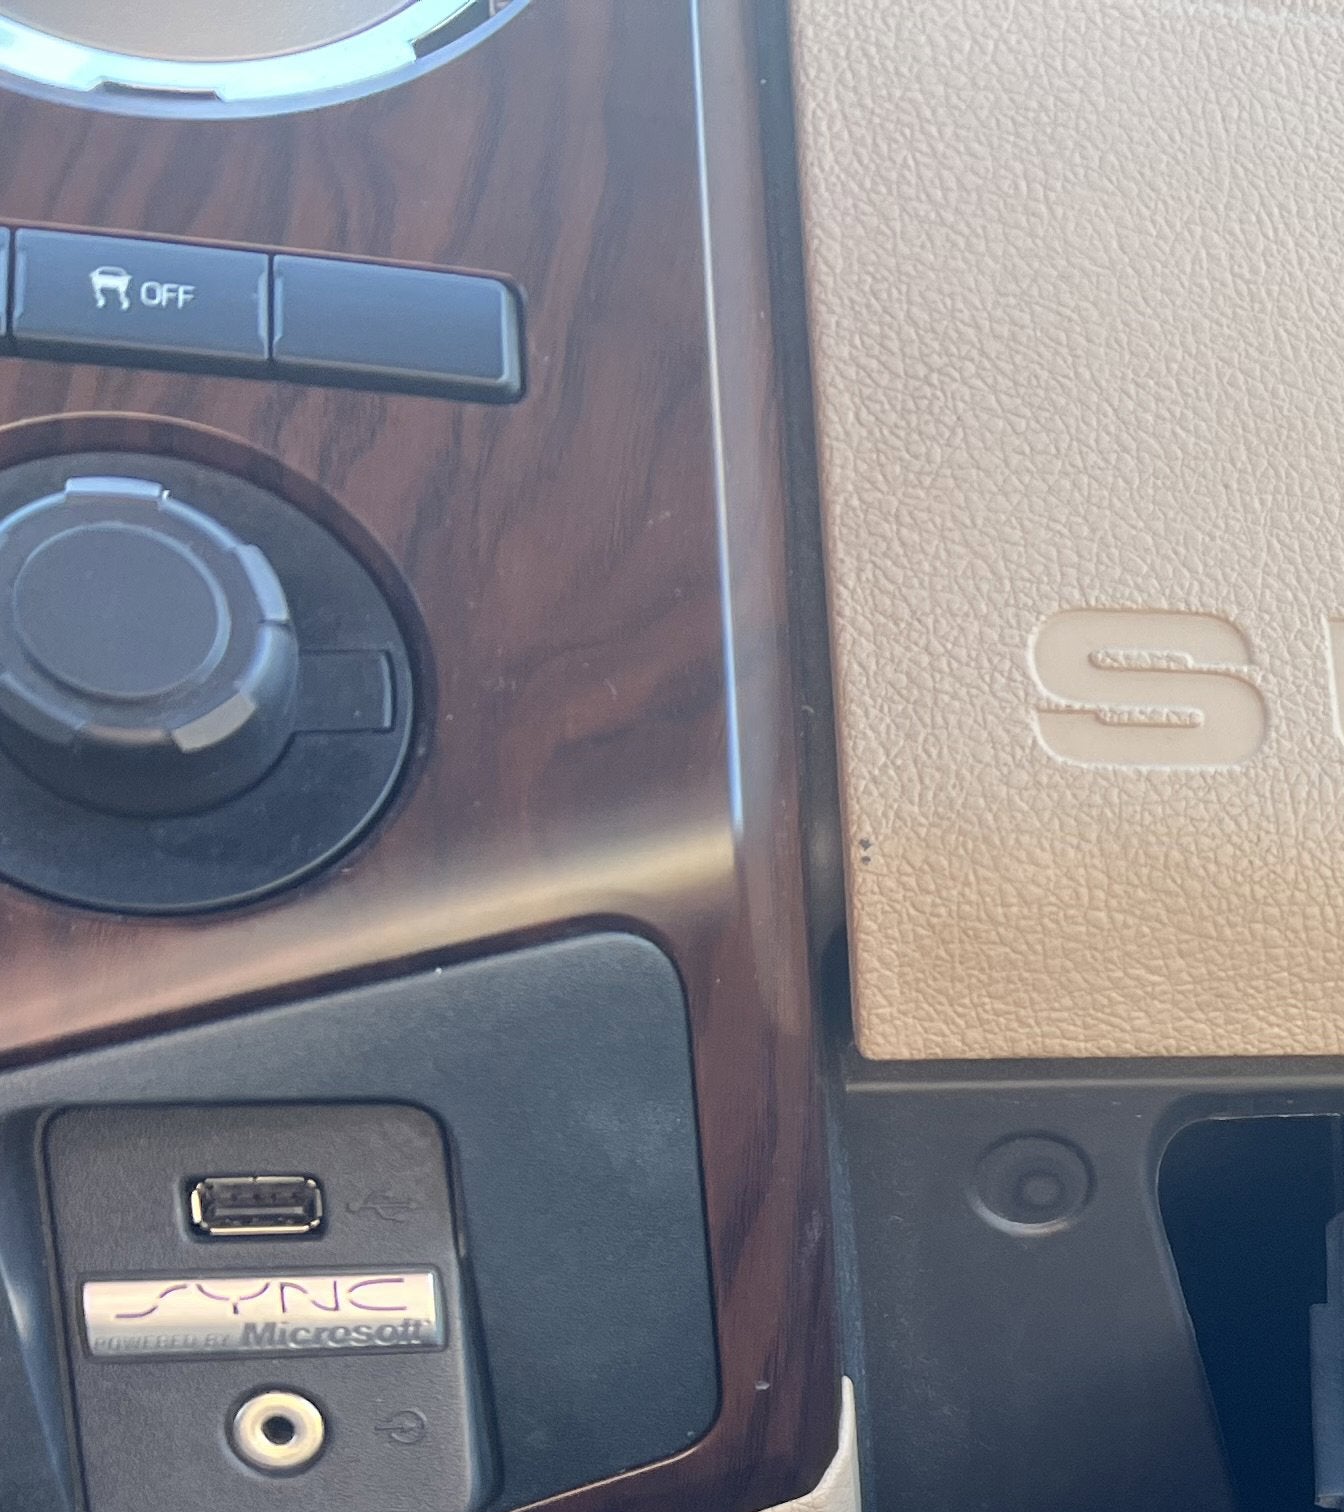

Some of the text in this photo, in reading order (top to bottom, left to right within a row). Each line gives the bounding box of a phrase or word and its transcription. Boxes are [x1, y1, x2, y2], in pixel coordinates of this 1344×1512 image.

[141, 281, 196, 309] OFF
[115, 1278, 407, 1319] SYNC
[241, 1318, 424, 1348] Microsoft
